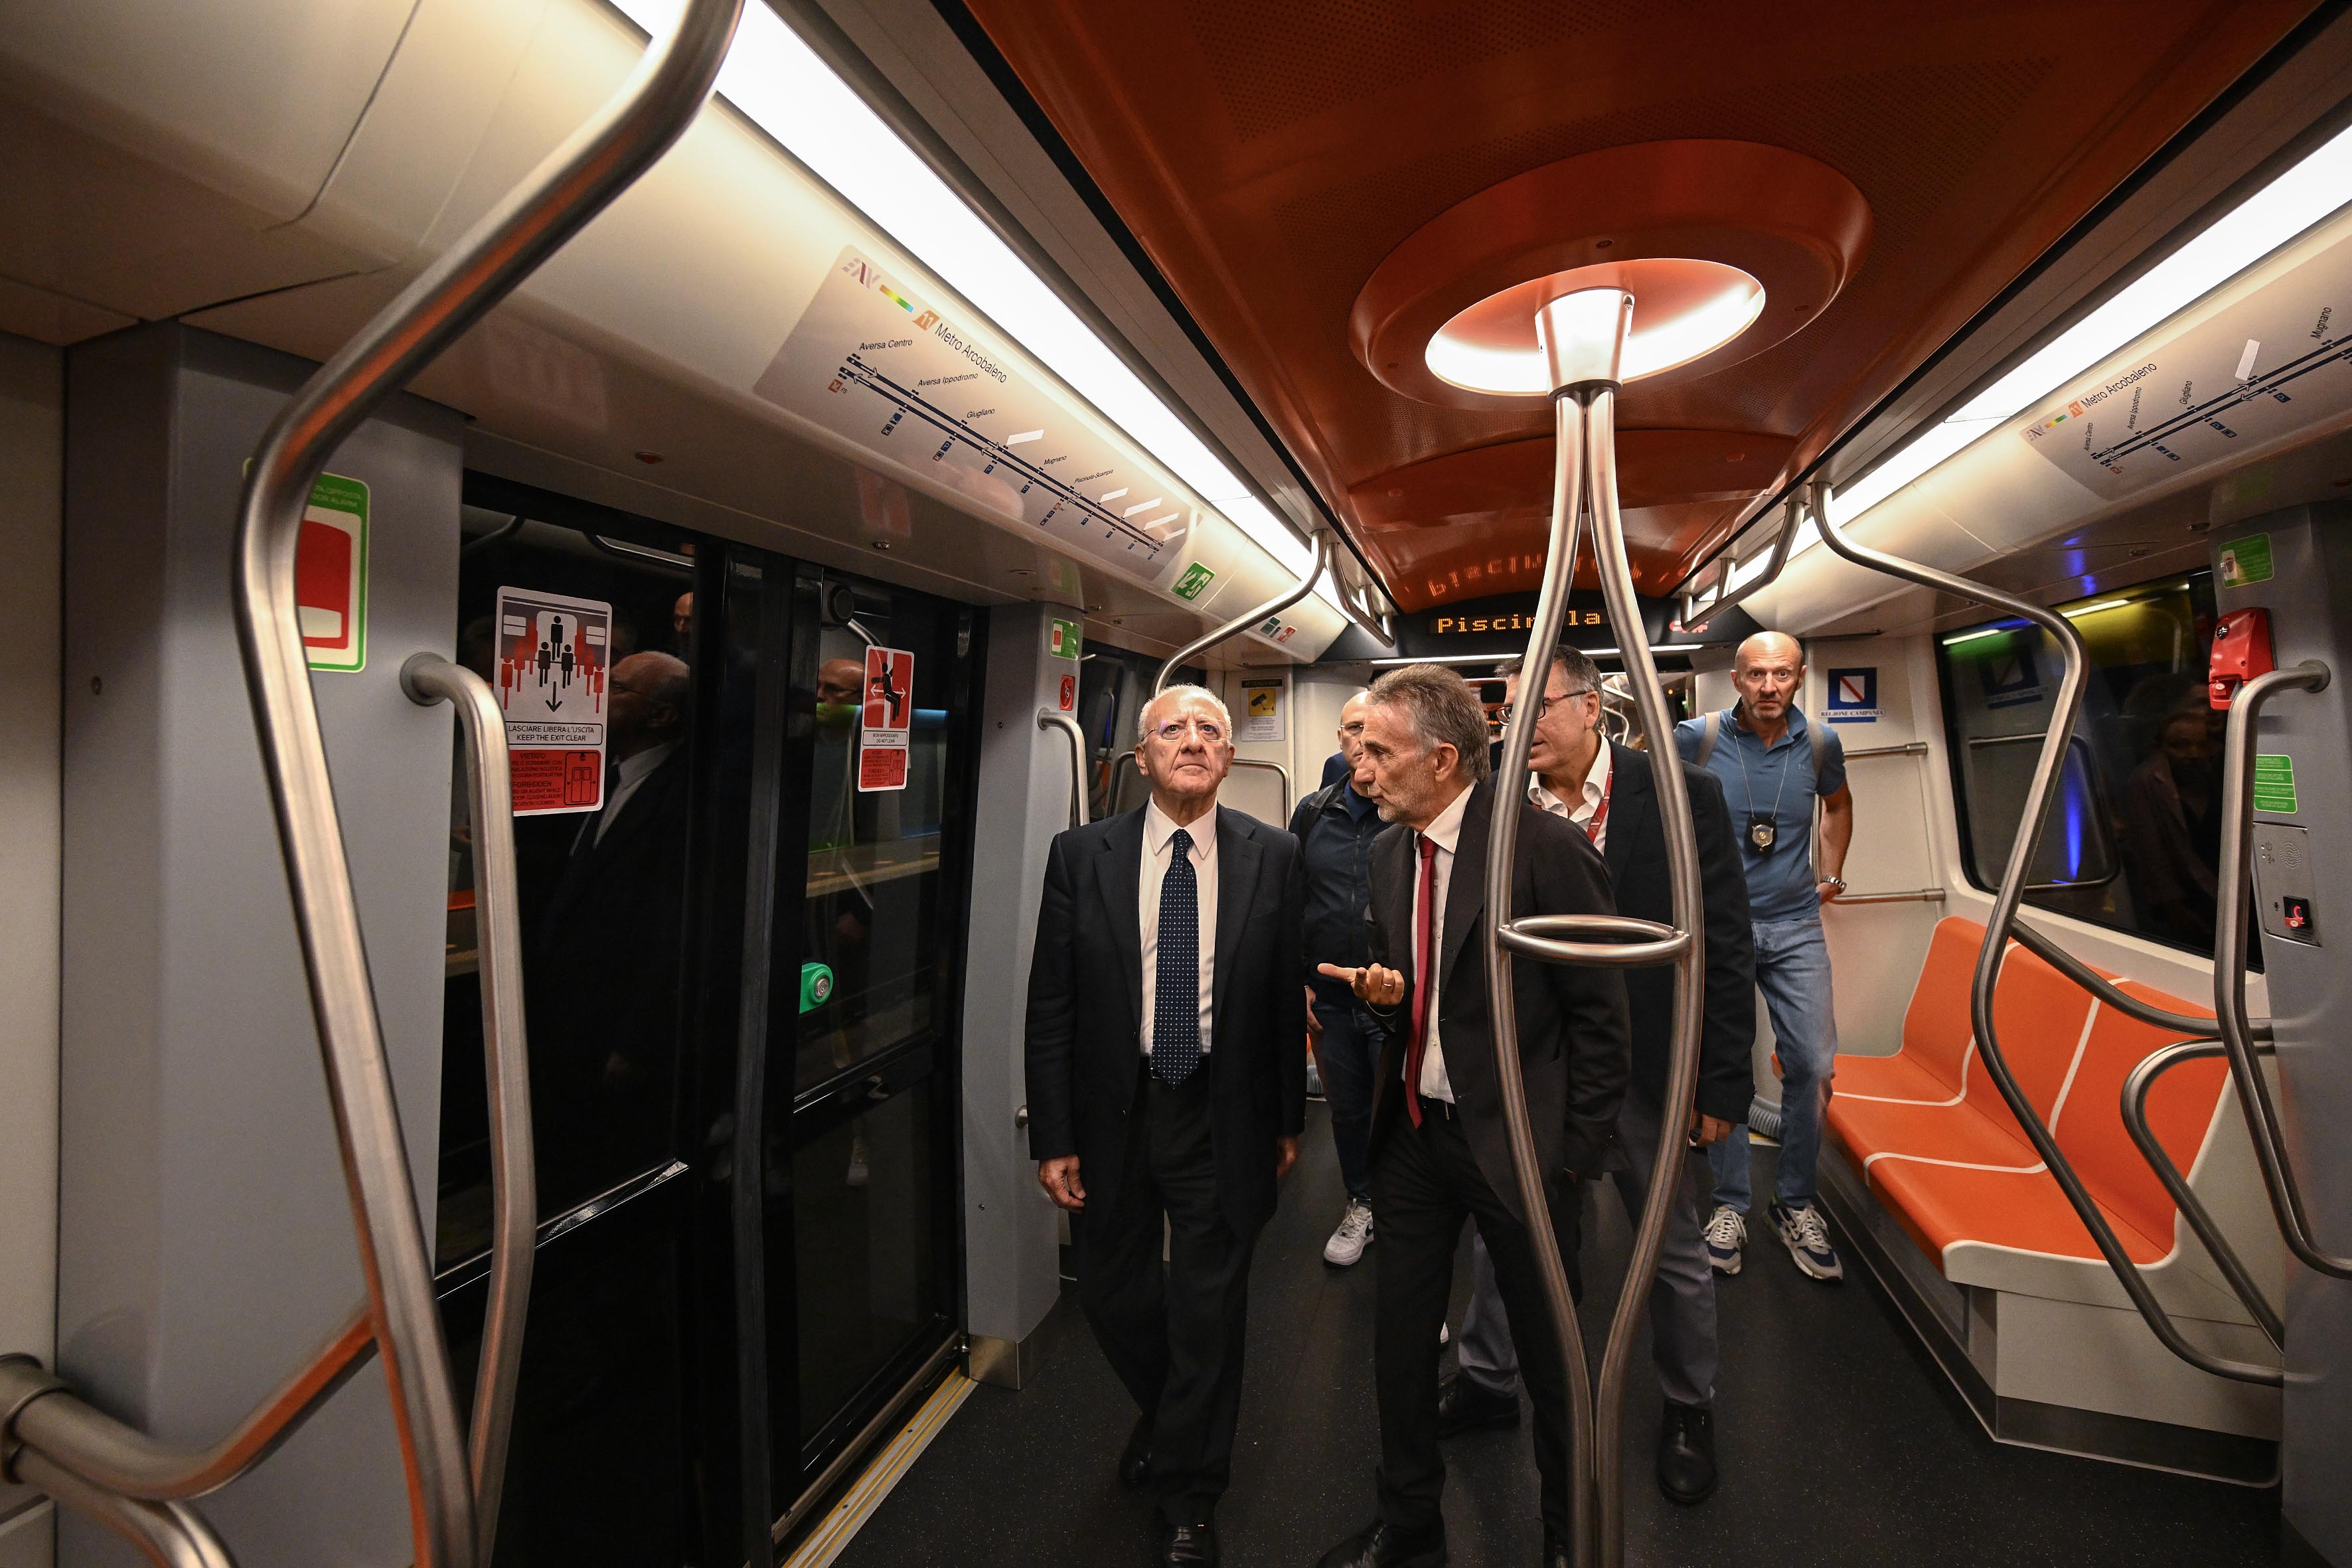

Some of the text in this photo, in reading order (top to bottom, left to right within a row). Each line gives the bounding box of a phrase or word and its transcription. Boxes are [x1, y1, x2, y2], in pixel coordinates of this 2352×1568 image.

[2310, 307, 2331, 339] Mugnano
[859, 339, 913, 351] Aversa Centro
[935, 322, 963, 351] Metro
[961, 343, 1008, 383] Arcobaleno
[917, 373, 979, 387] Aversa Ippodromo
[2080, 391, 2108, 408] Metro
[2106, 361, 2157, 395] Arcobaleno
[2179, 380, 2193, 405] Giugliano
[967, 408, 995, 419] Giugliano
[2127, 386, 2142, 430] Aversa Ippodromo
[1044, 455, 1067, 465] Mugnano
